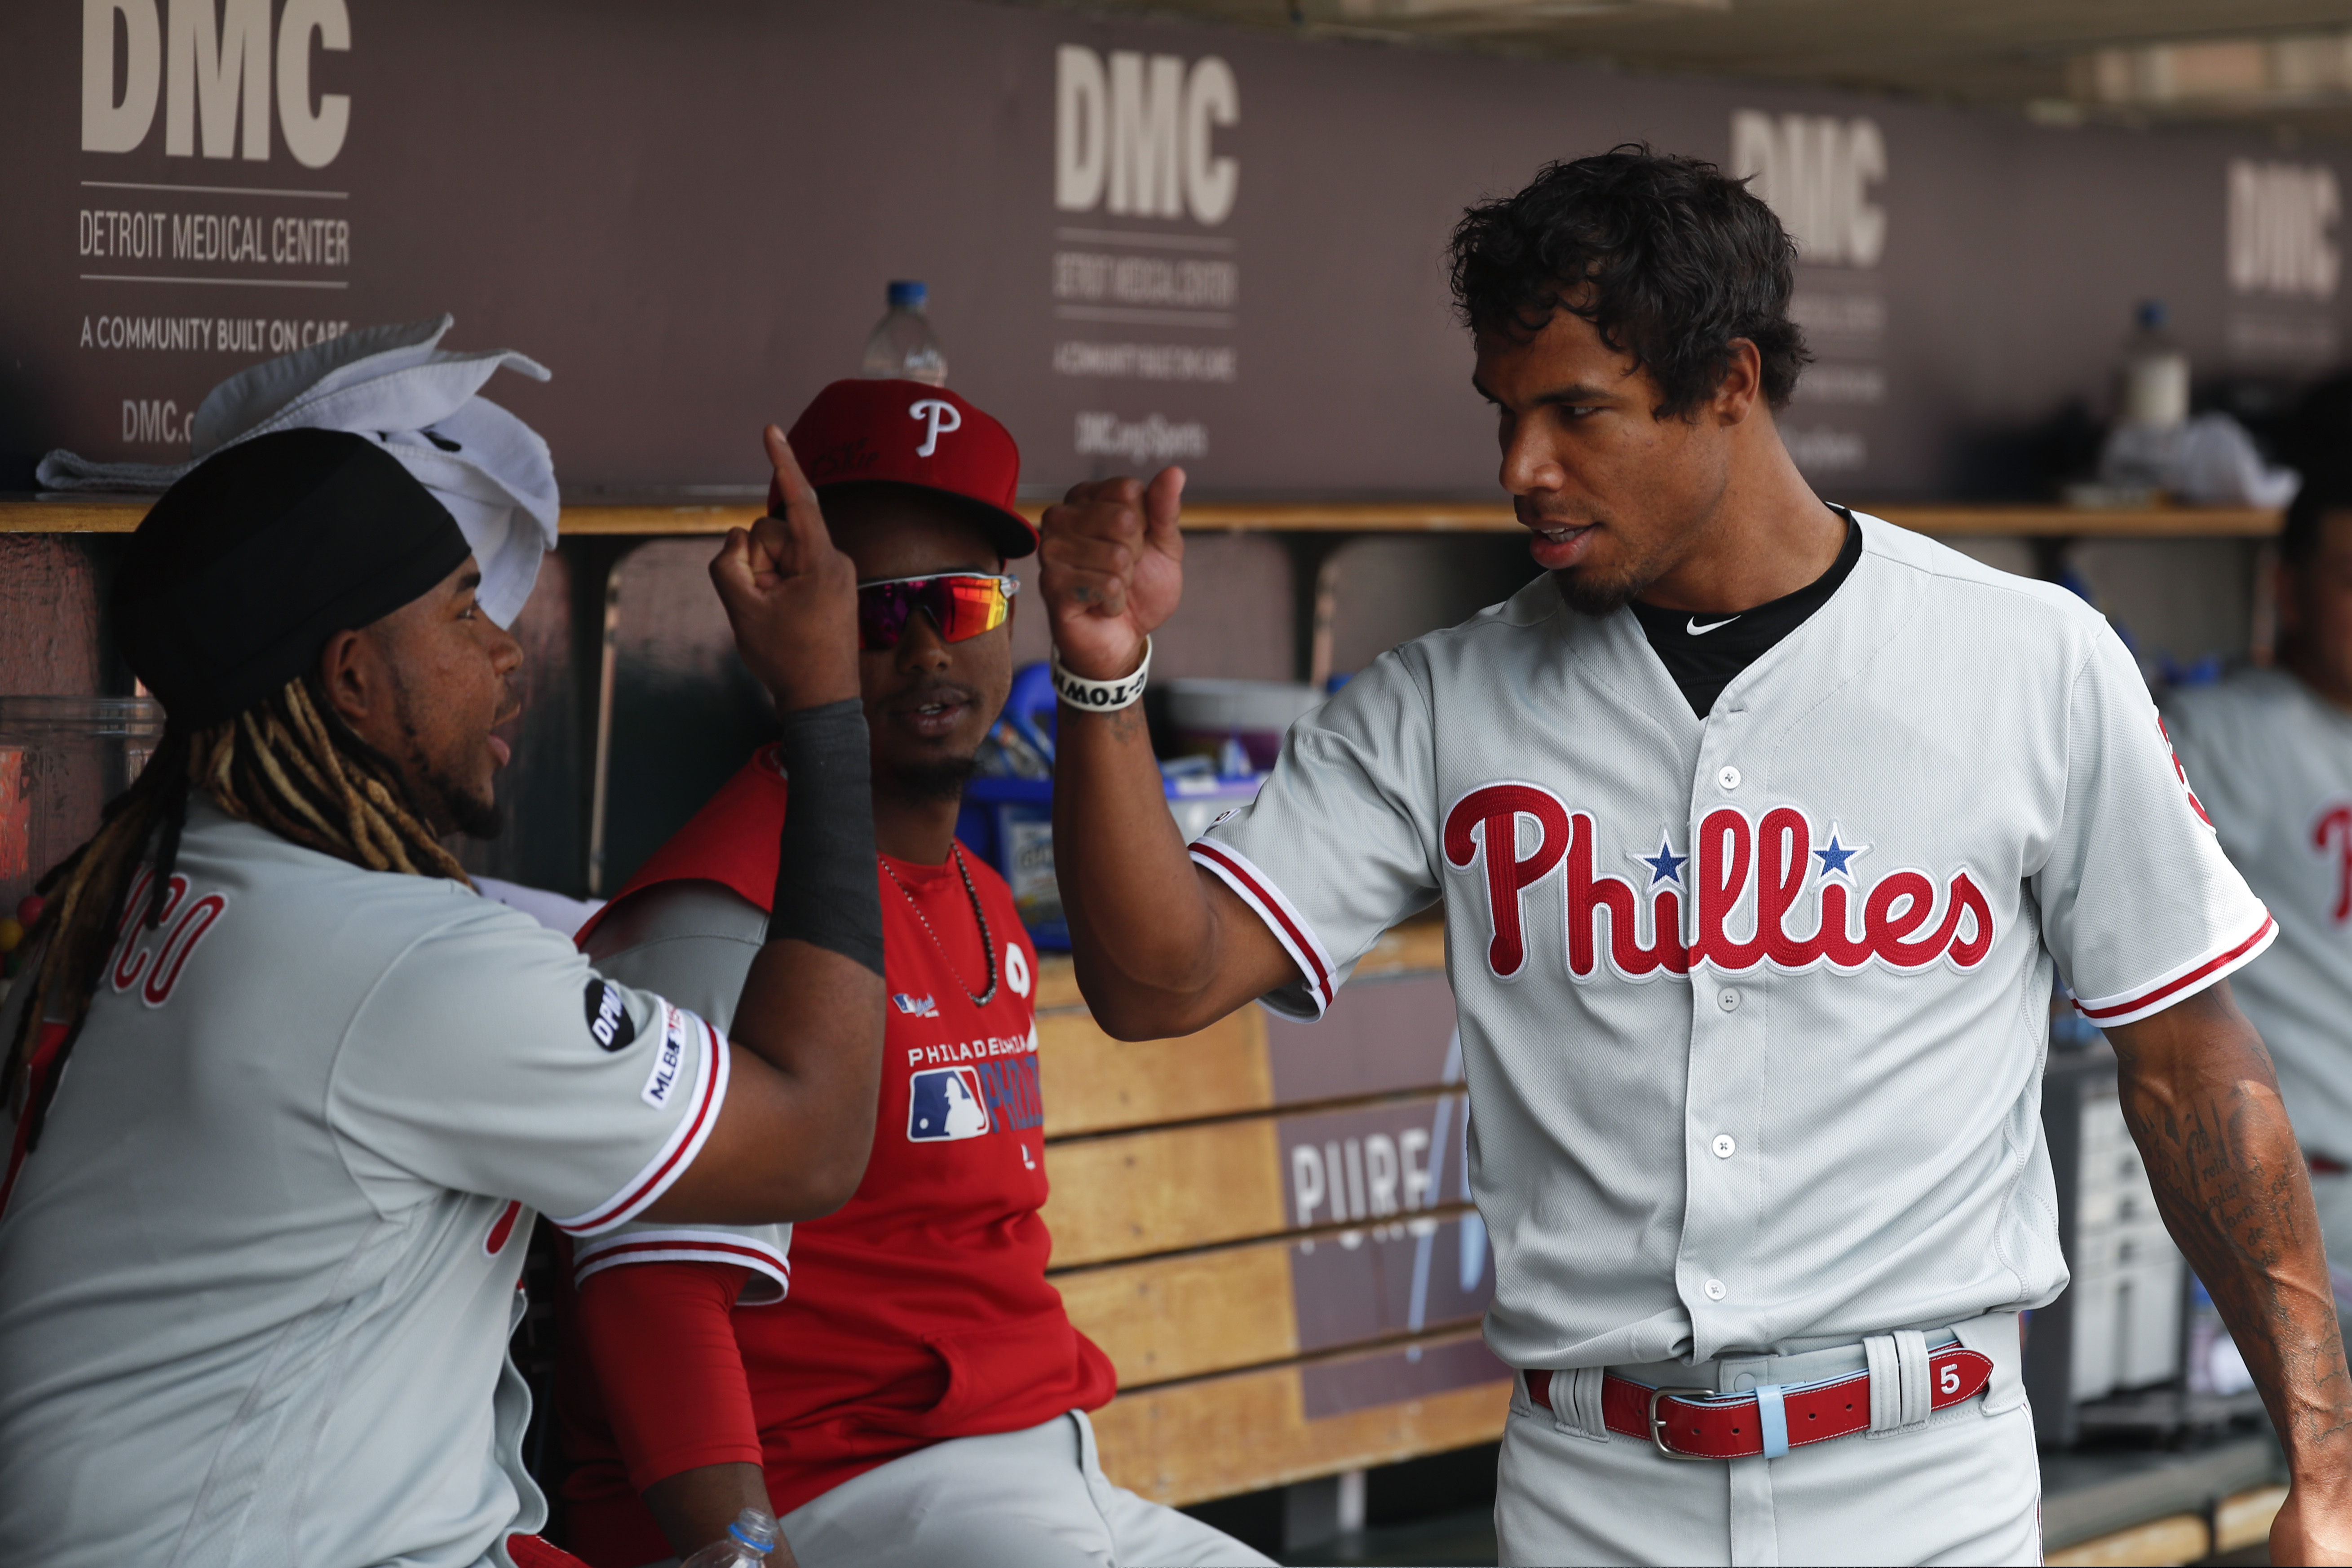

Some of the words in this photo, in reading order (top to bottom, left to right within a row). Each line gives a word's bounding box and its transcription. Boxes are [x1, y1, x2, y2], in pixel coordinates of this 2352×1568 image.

[81, 0, 352, 169] DMC
[1054, 43, 1240, 226] DMC
[80, 209, 166, 259] DETROIT
[172, 213, 268, 264] MEDICAL
[272, 218, 350, 266] CENTER
[80, 315, 93, 349] A
[97, 315, 213, 351] COMMUNITY
[217, 318, 266, 352] BUILT
[270, 318, 299, 353] ON
[908, 398, 962, 458] P
[1441, 781, 1998, 983] Phillies
[650, 1052, 678, 1100] MLB
[1291, 1127, 1438, 1255] PURE
[1940, 1363, 1960, 1395] 5
